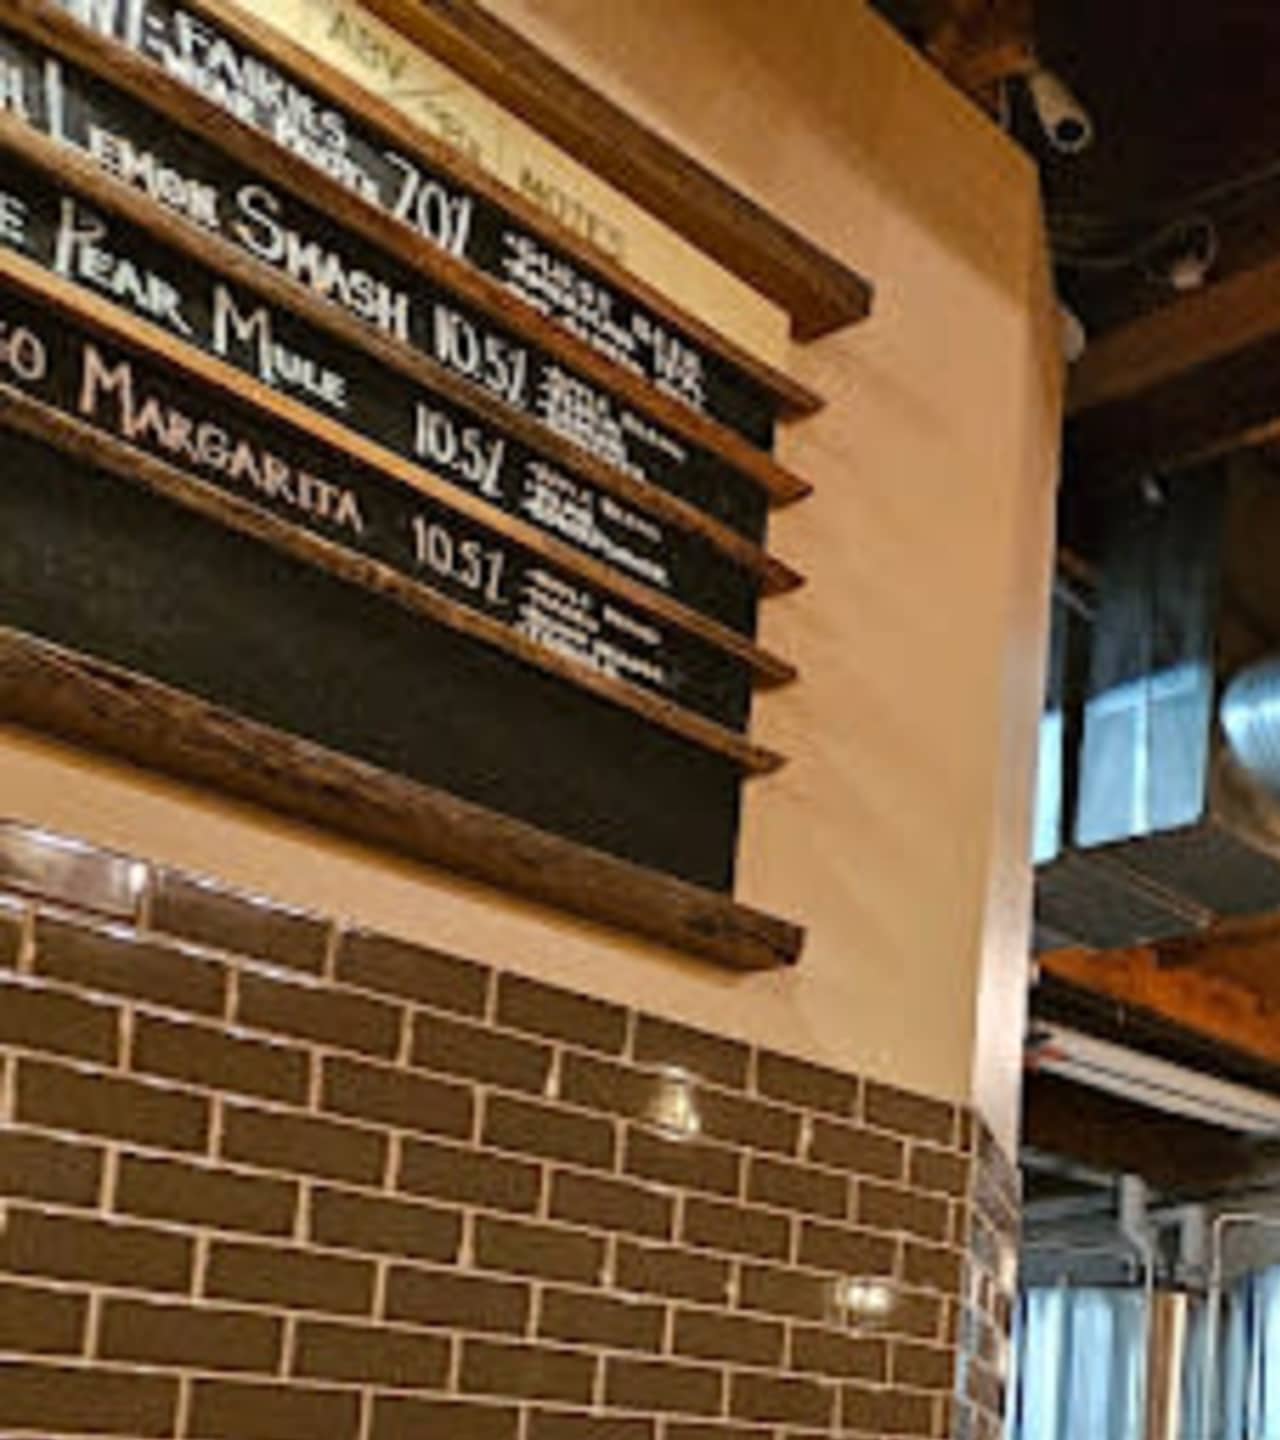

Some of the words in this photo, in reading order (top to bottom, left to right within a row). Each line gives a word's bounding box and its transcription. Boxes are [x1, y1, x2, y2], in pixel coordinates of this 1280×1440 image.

[52, 197, 193, 335] PEAR
[211, 284, 347, 409] MULE
[230, 185, 409, 342] SMASH
[80, 345, 364, 533] MARGARITA
